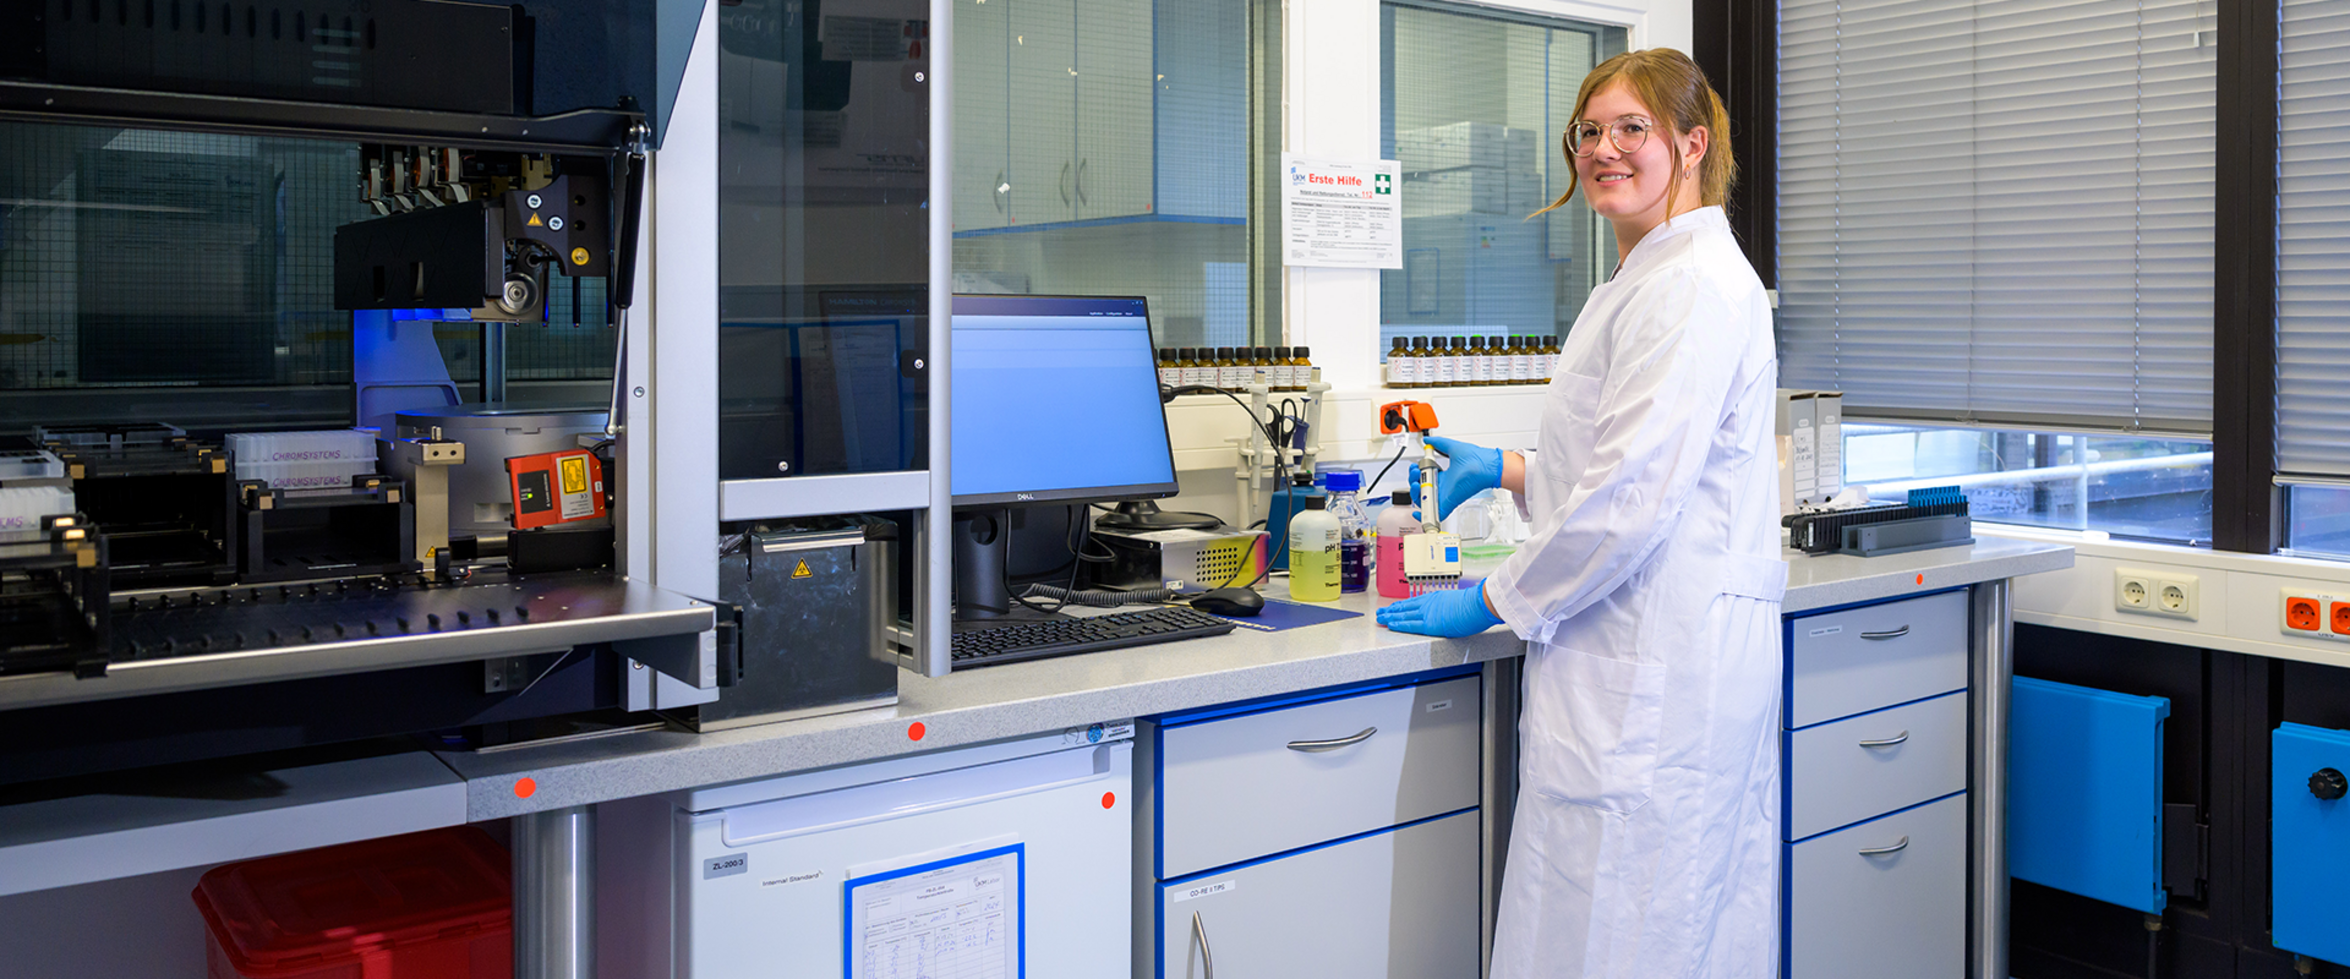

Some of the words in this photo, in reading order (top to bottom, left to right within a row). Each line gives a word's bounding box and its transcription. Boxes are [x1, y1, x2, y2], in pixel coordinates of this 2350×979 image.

[1309, 173, 1334, 185] Erste
[1337, 175, 1362, 186] Hilfe
[1362, 191, 1373, 199] 112
[272, 450, 341, 461] CHROMSYSTEMS
[272, 476, 341, 487] CHROMSYSTEMS
[1325, 543, 1336, 554] pH
[762, 877, 788, 887] Internal
